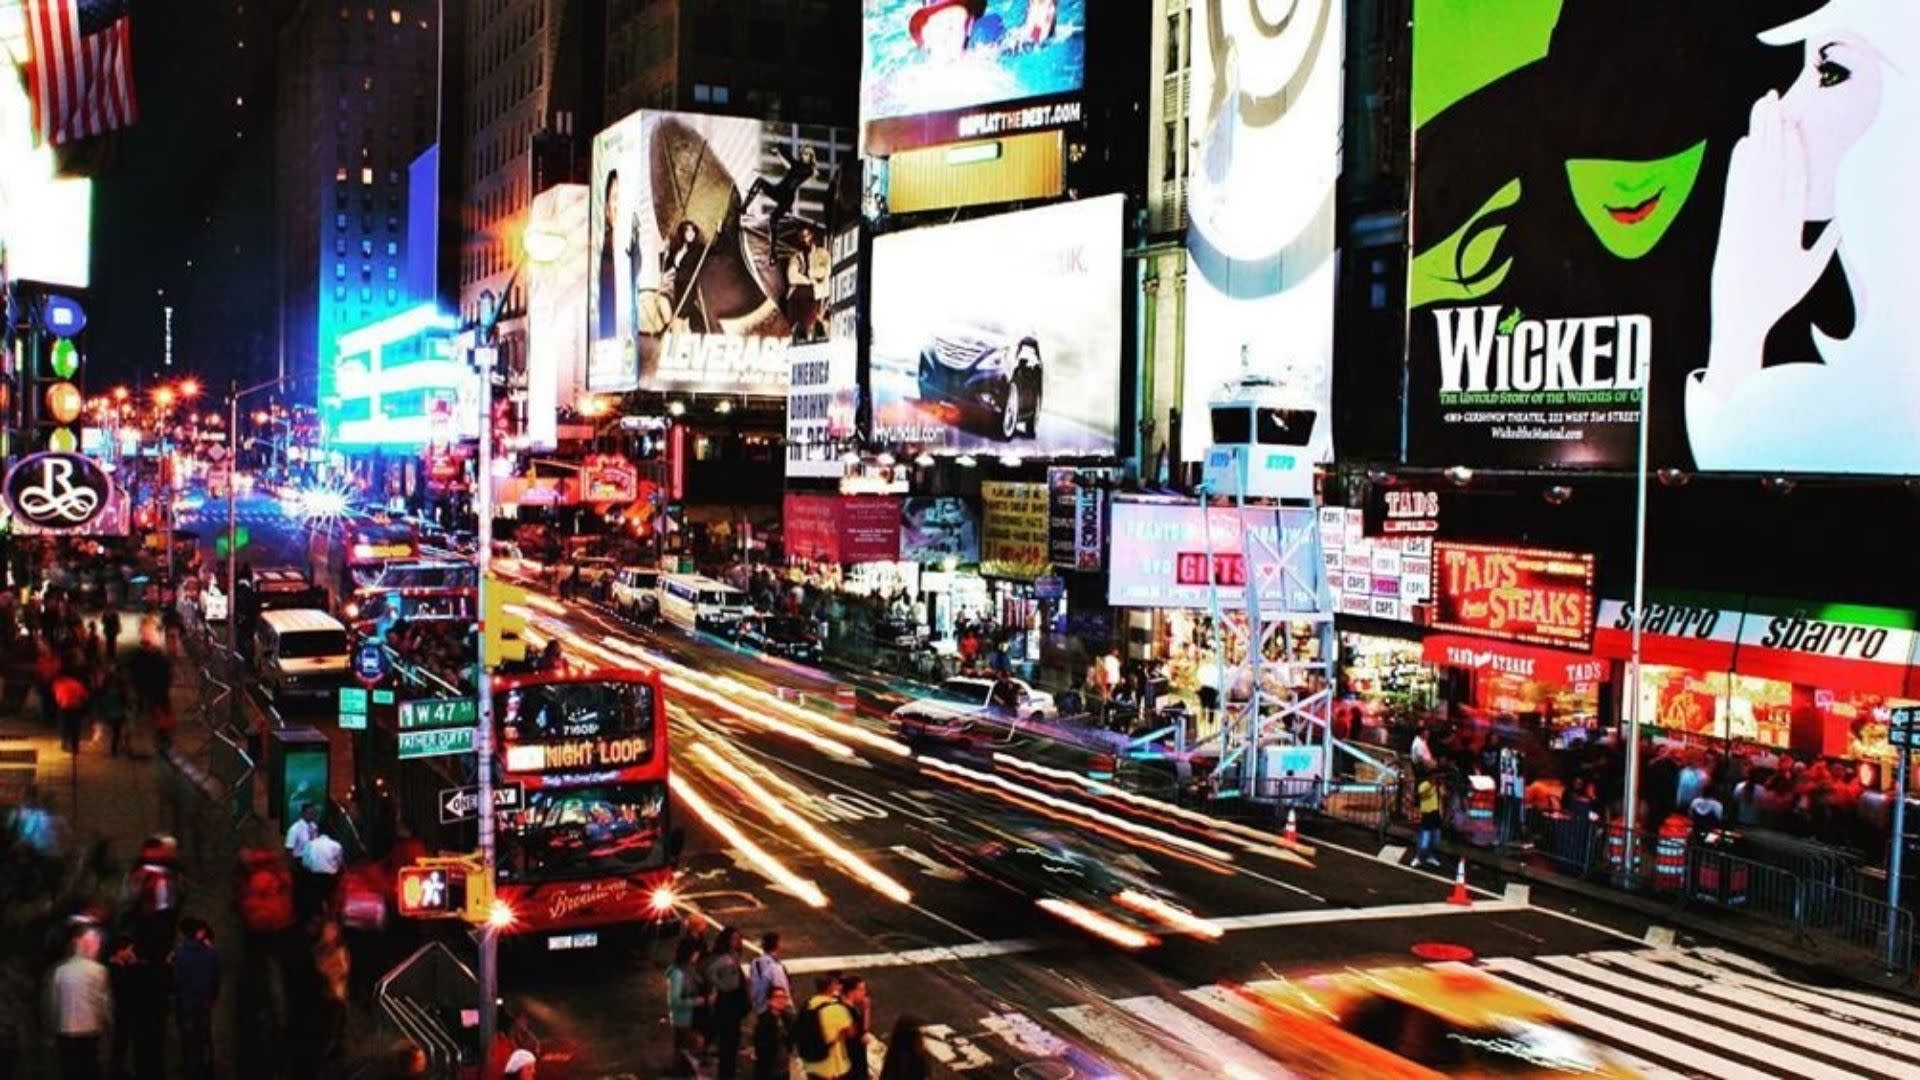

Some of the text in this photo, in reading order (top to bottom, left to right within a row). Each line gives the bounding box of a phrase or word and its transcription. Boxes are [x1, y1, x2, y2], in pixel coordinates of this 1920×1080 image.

[1760, 615, 1888, 660] sbarro
[416, 703, 430, 723] W
[433, 702, 457, 722] 47
[546, 740, 644, 768] NIGHT LOOP
